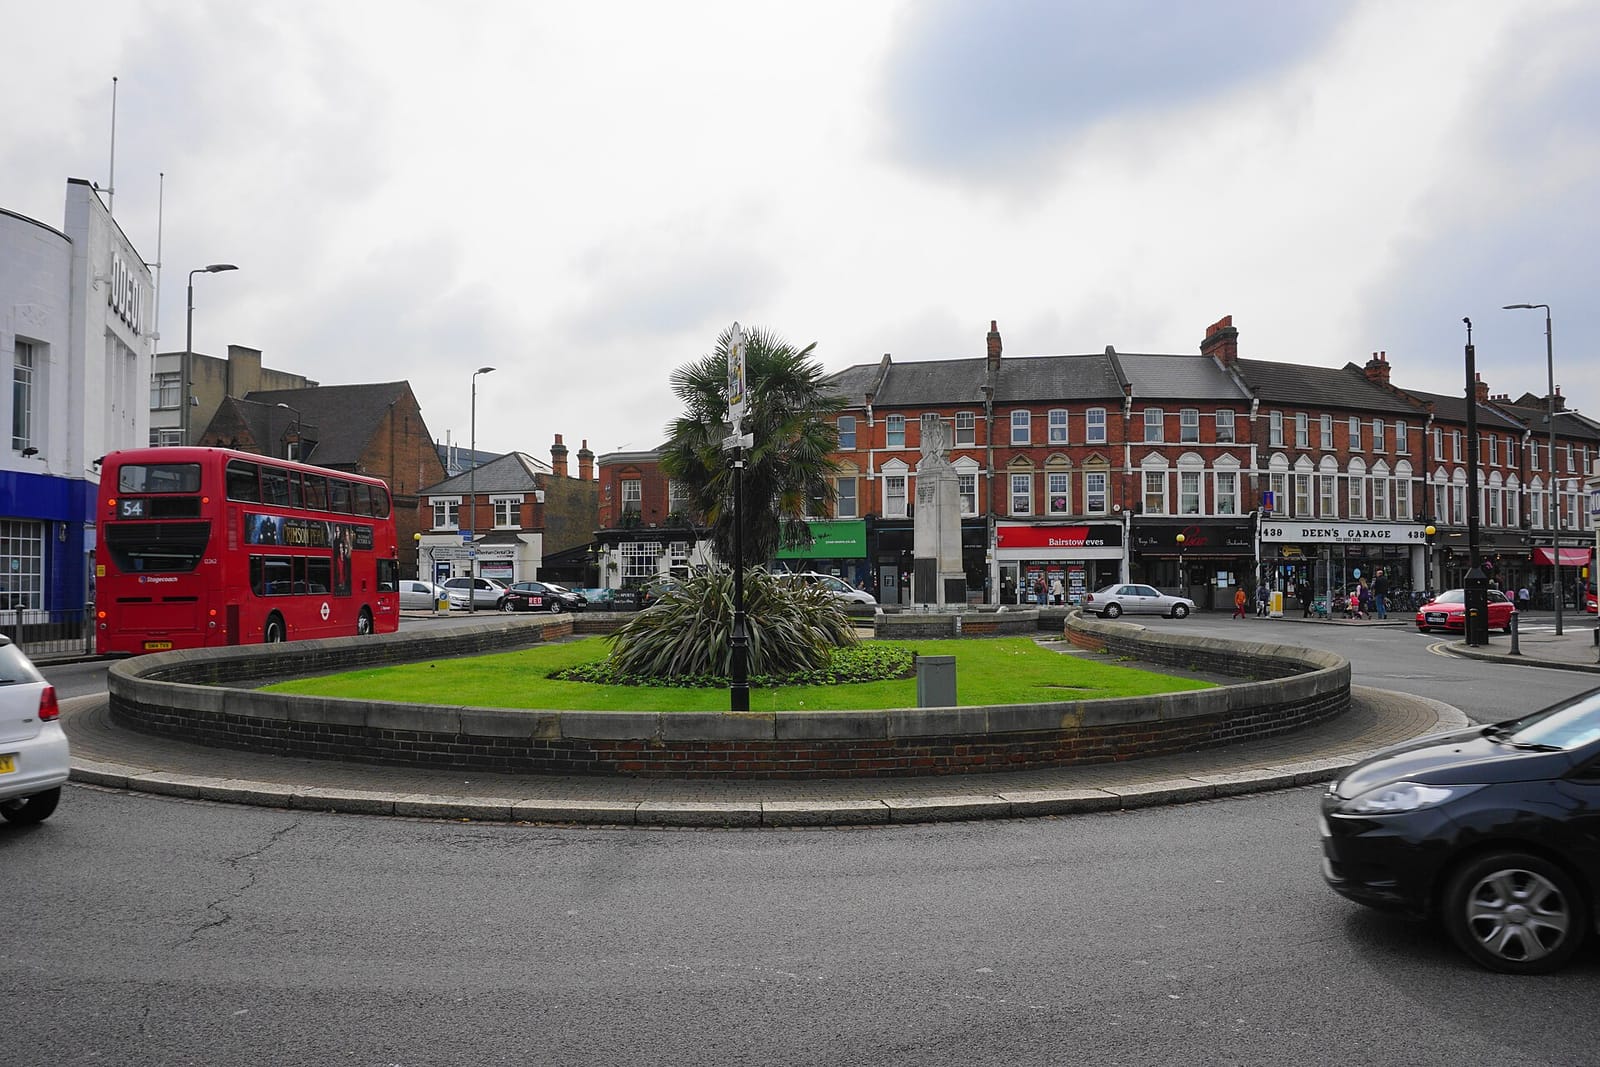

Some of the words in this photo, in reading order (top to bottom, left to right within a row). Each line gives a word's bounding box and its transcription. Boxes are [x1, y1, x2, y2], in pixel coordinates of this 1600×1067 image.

[112, 252, 144, 335] ODEON
[123, 501, 142, 516] 54
[284, 524, 309, 545] CRIMSON
[1302, 527, 1339, 538] DEEN'S
[1347, 530, 1391, 538] GARAGE
[1049, 538, 1084, 546] Bairstow
